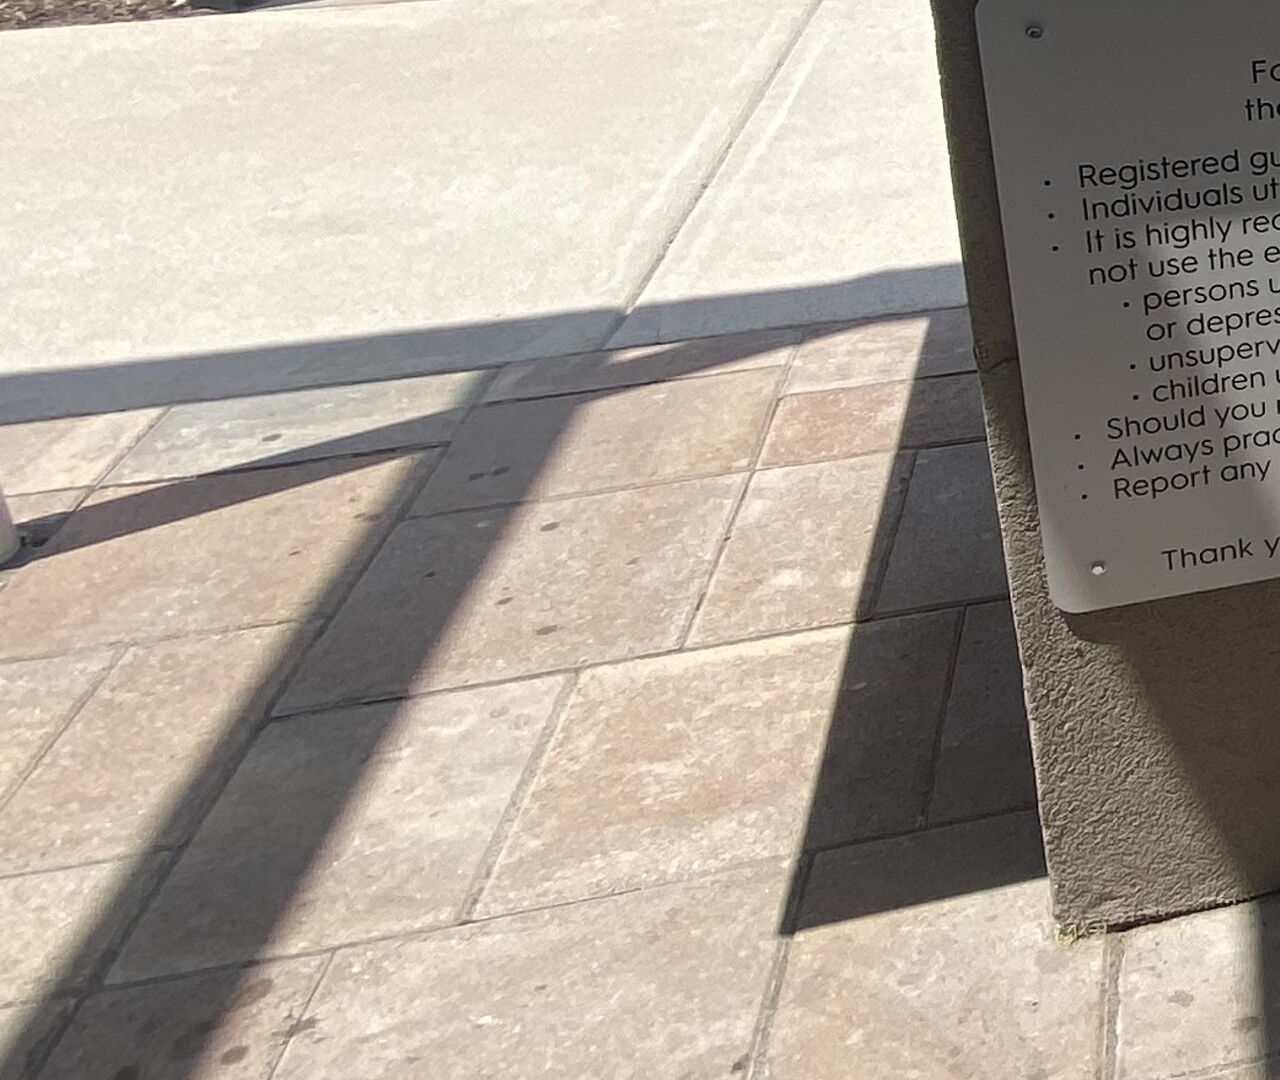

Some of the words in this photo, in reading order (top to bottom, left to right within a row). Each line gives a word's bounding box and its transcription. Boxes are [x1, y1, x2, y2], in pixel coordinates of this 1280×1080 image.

[1078, 148, 1240, 190] Registered
[1082, 182, 1244, 221] Individuals
[1086, 229, 1105, 254] It
[1114, 227, 1136, 250] is
[1145, 216, 1232, 249] highly
[1089, 258, 1138, 286] not
[1148, 256, 1198, 278] use
[1208, 247, 1254, 270] the
[1143, 279, 1260, 316] persons
[1146, 321, 1178, 341] or
[1152, 371, 1266, 402] children
[1107, 404, 1206, 440] Should
[1214, 401, 1266, 429] you
[1110, 439, 1214, 470] Always
[1113, 464, 1211, 500] Report
[1220, 460, 1271, 482] any
[1160, 538, 1254, 571] Thank
